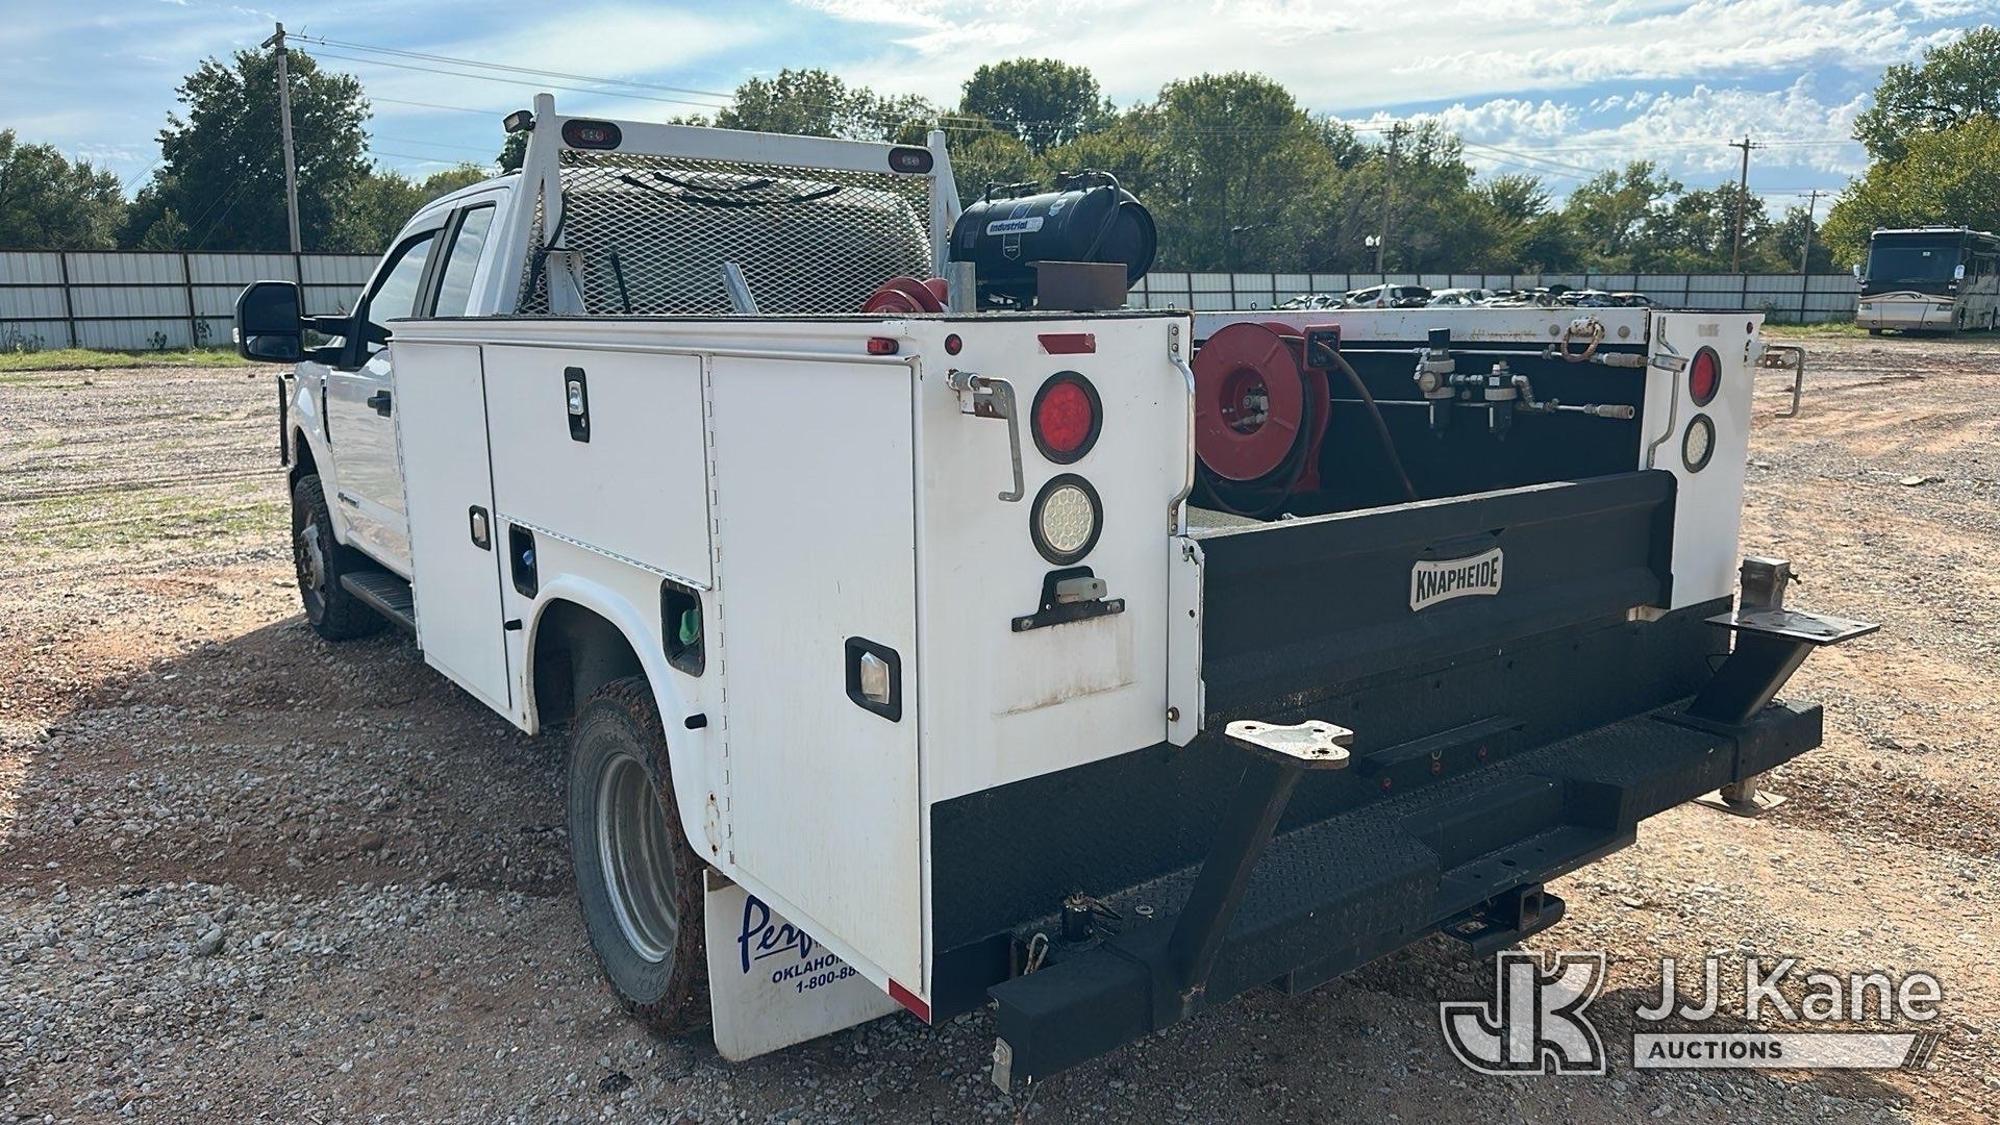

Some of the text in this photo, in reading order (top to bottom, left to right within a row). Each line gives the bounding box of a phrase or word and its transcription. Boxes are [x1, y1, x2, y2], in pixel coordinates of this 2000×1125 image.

[990, 220, 1027, 232] Industrial
[1415, 556, 1499, 603] KNAPHEIDE
[796, 965, 860, 993] 1-800-88
